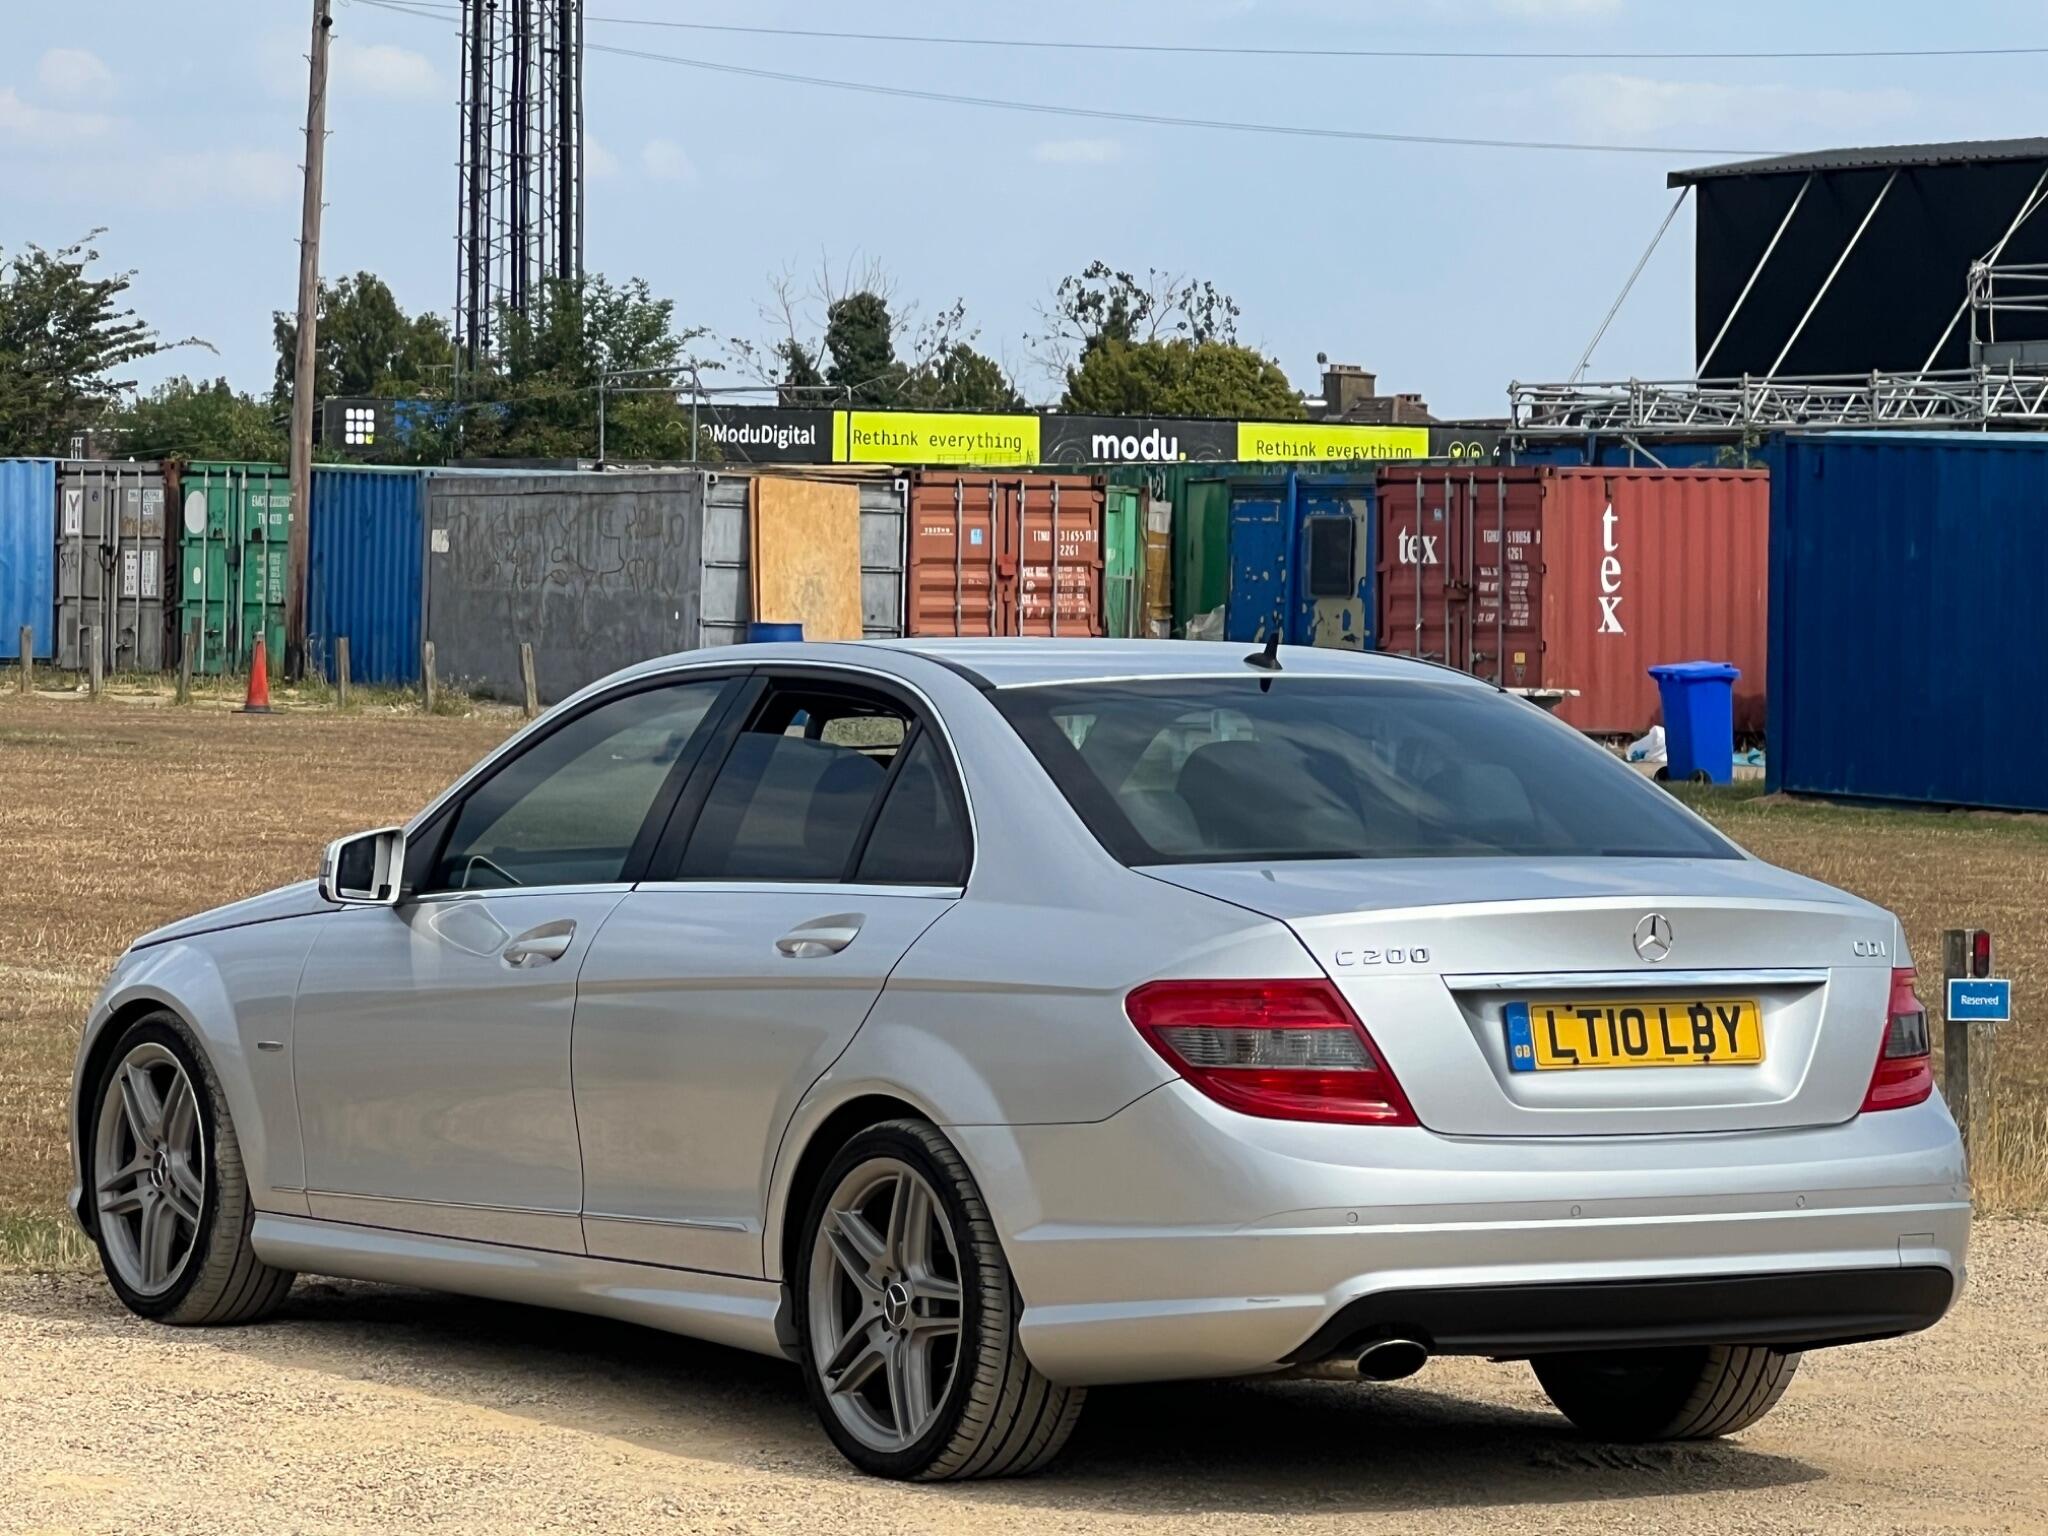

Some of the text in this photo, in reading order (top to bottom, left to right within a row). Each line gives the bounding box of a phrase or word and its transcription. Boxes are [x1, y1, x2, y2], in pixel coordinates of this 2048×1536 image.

[853, 429, 1022, 452] Rethink everything
[1091, 428, 1187, 461] modu.
[1256, 440, 1317, 457] Rethink
[1398, 525, 1439, 564] tex
[1597, 503, 1624, 633] tex
[1335, 948, 1430, 967] C 200
[1853, 940, 1887, 957] CDI
[1960, 994, 2000, 1007] Reserved
[1546, 1005, 1741, 1058] LT10 LBY
[1514, 1044, 1531, 1058] GB
